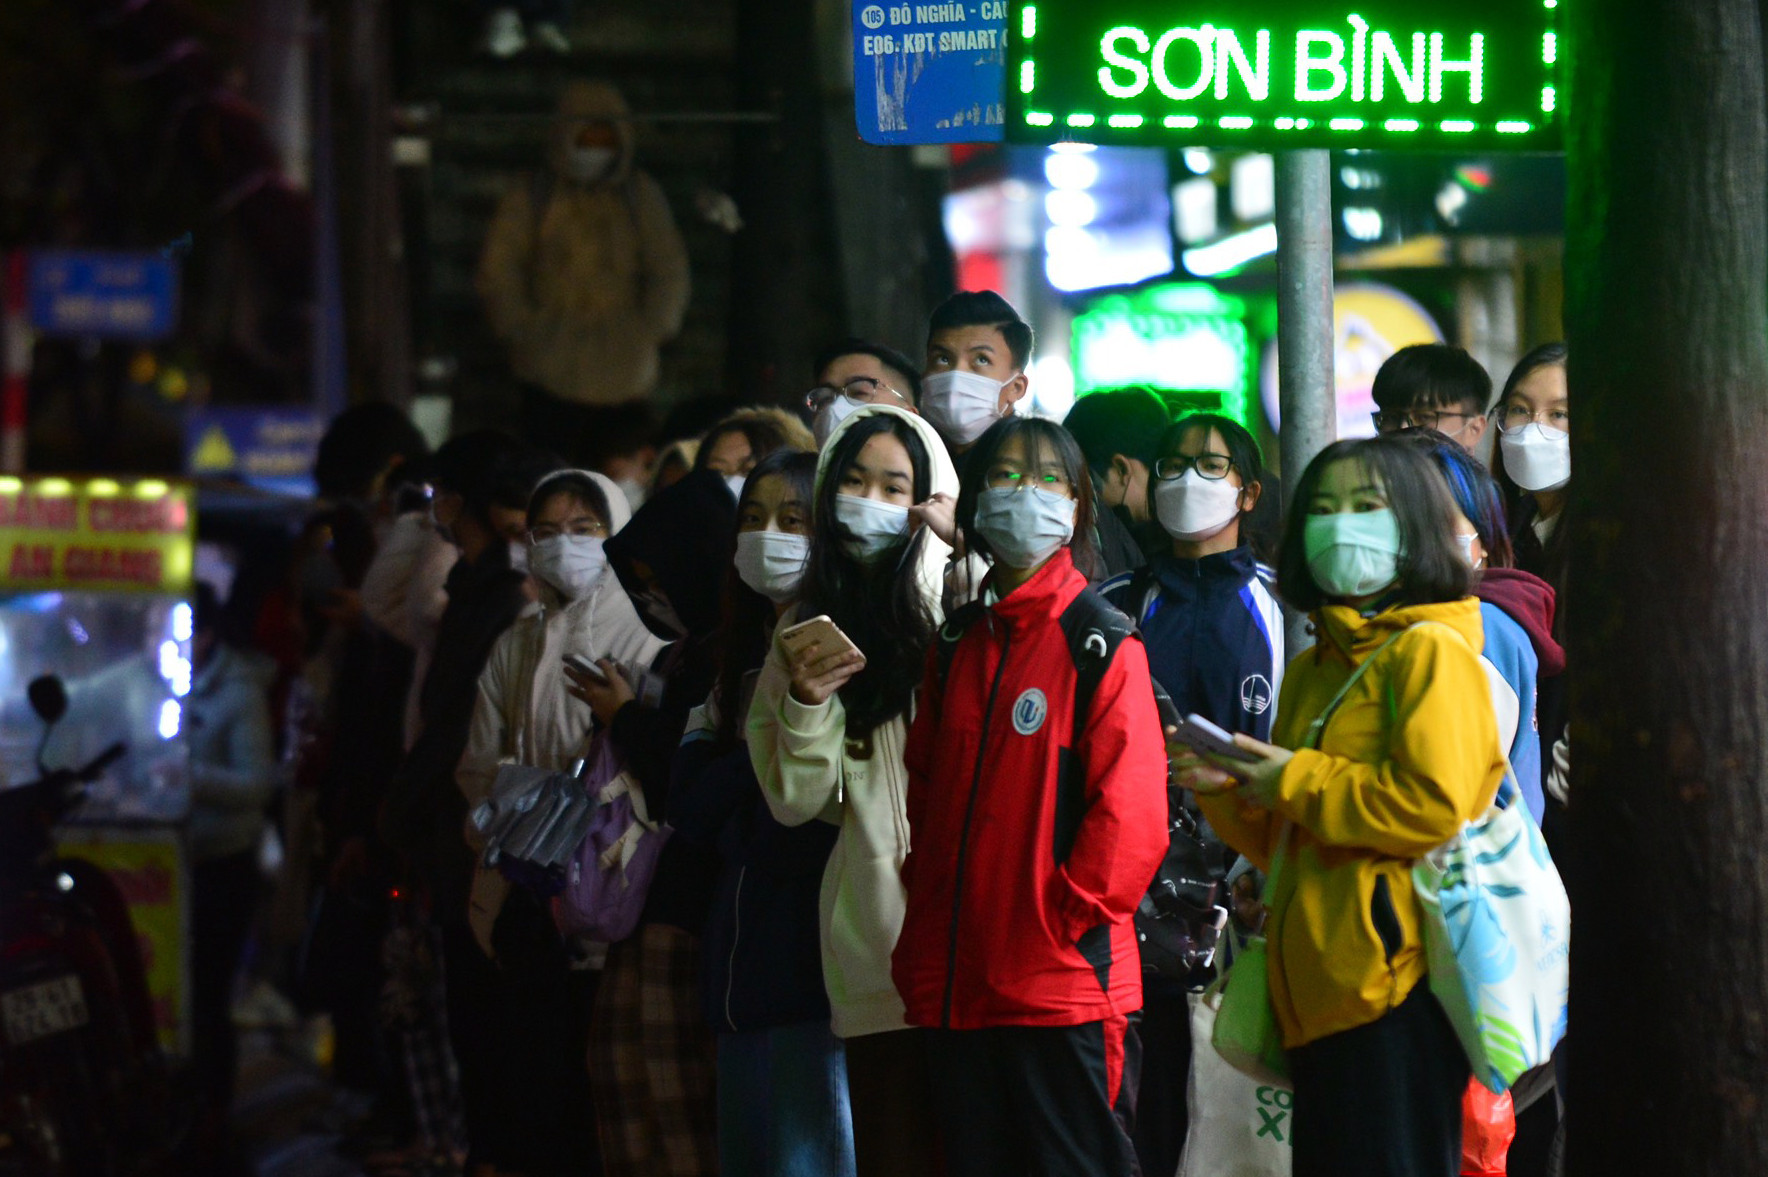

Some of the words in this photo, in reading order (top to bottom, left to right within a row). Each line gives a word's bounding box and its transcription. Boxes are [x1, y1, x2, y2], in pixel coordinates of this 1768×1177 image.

[865, 9, 881, 23] 105
[939, 29, 997, 51] SMART
[1098, 23, 1269, 101] SƠN
[1294, 13, 1484, 104] BÌNH
[1256, 1106, 1293, 1146] X
